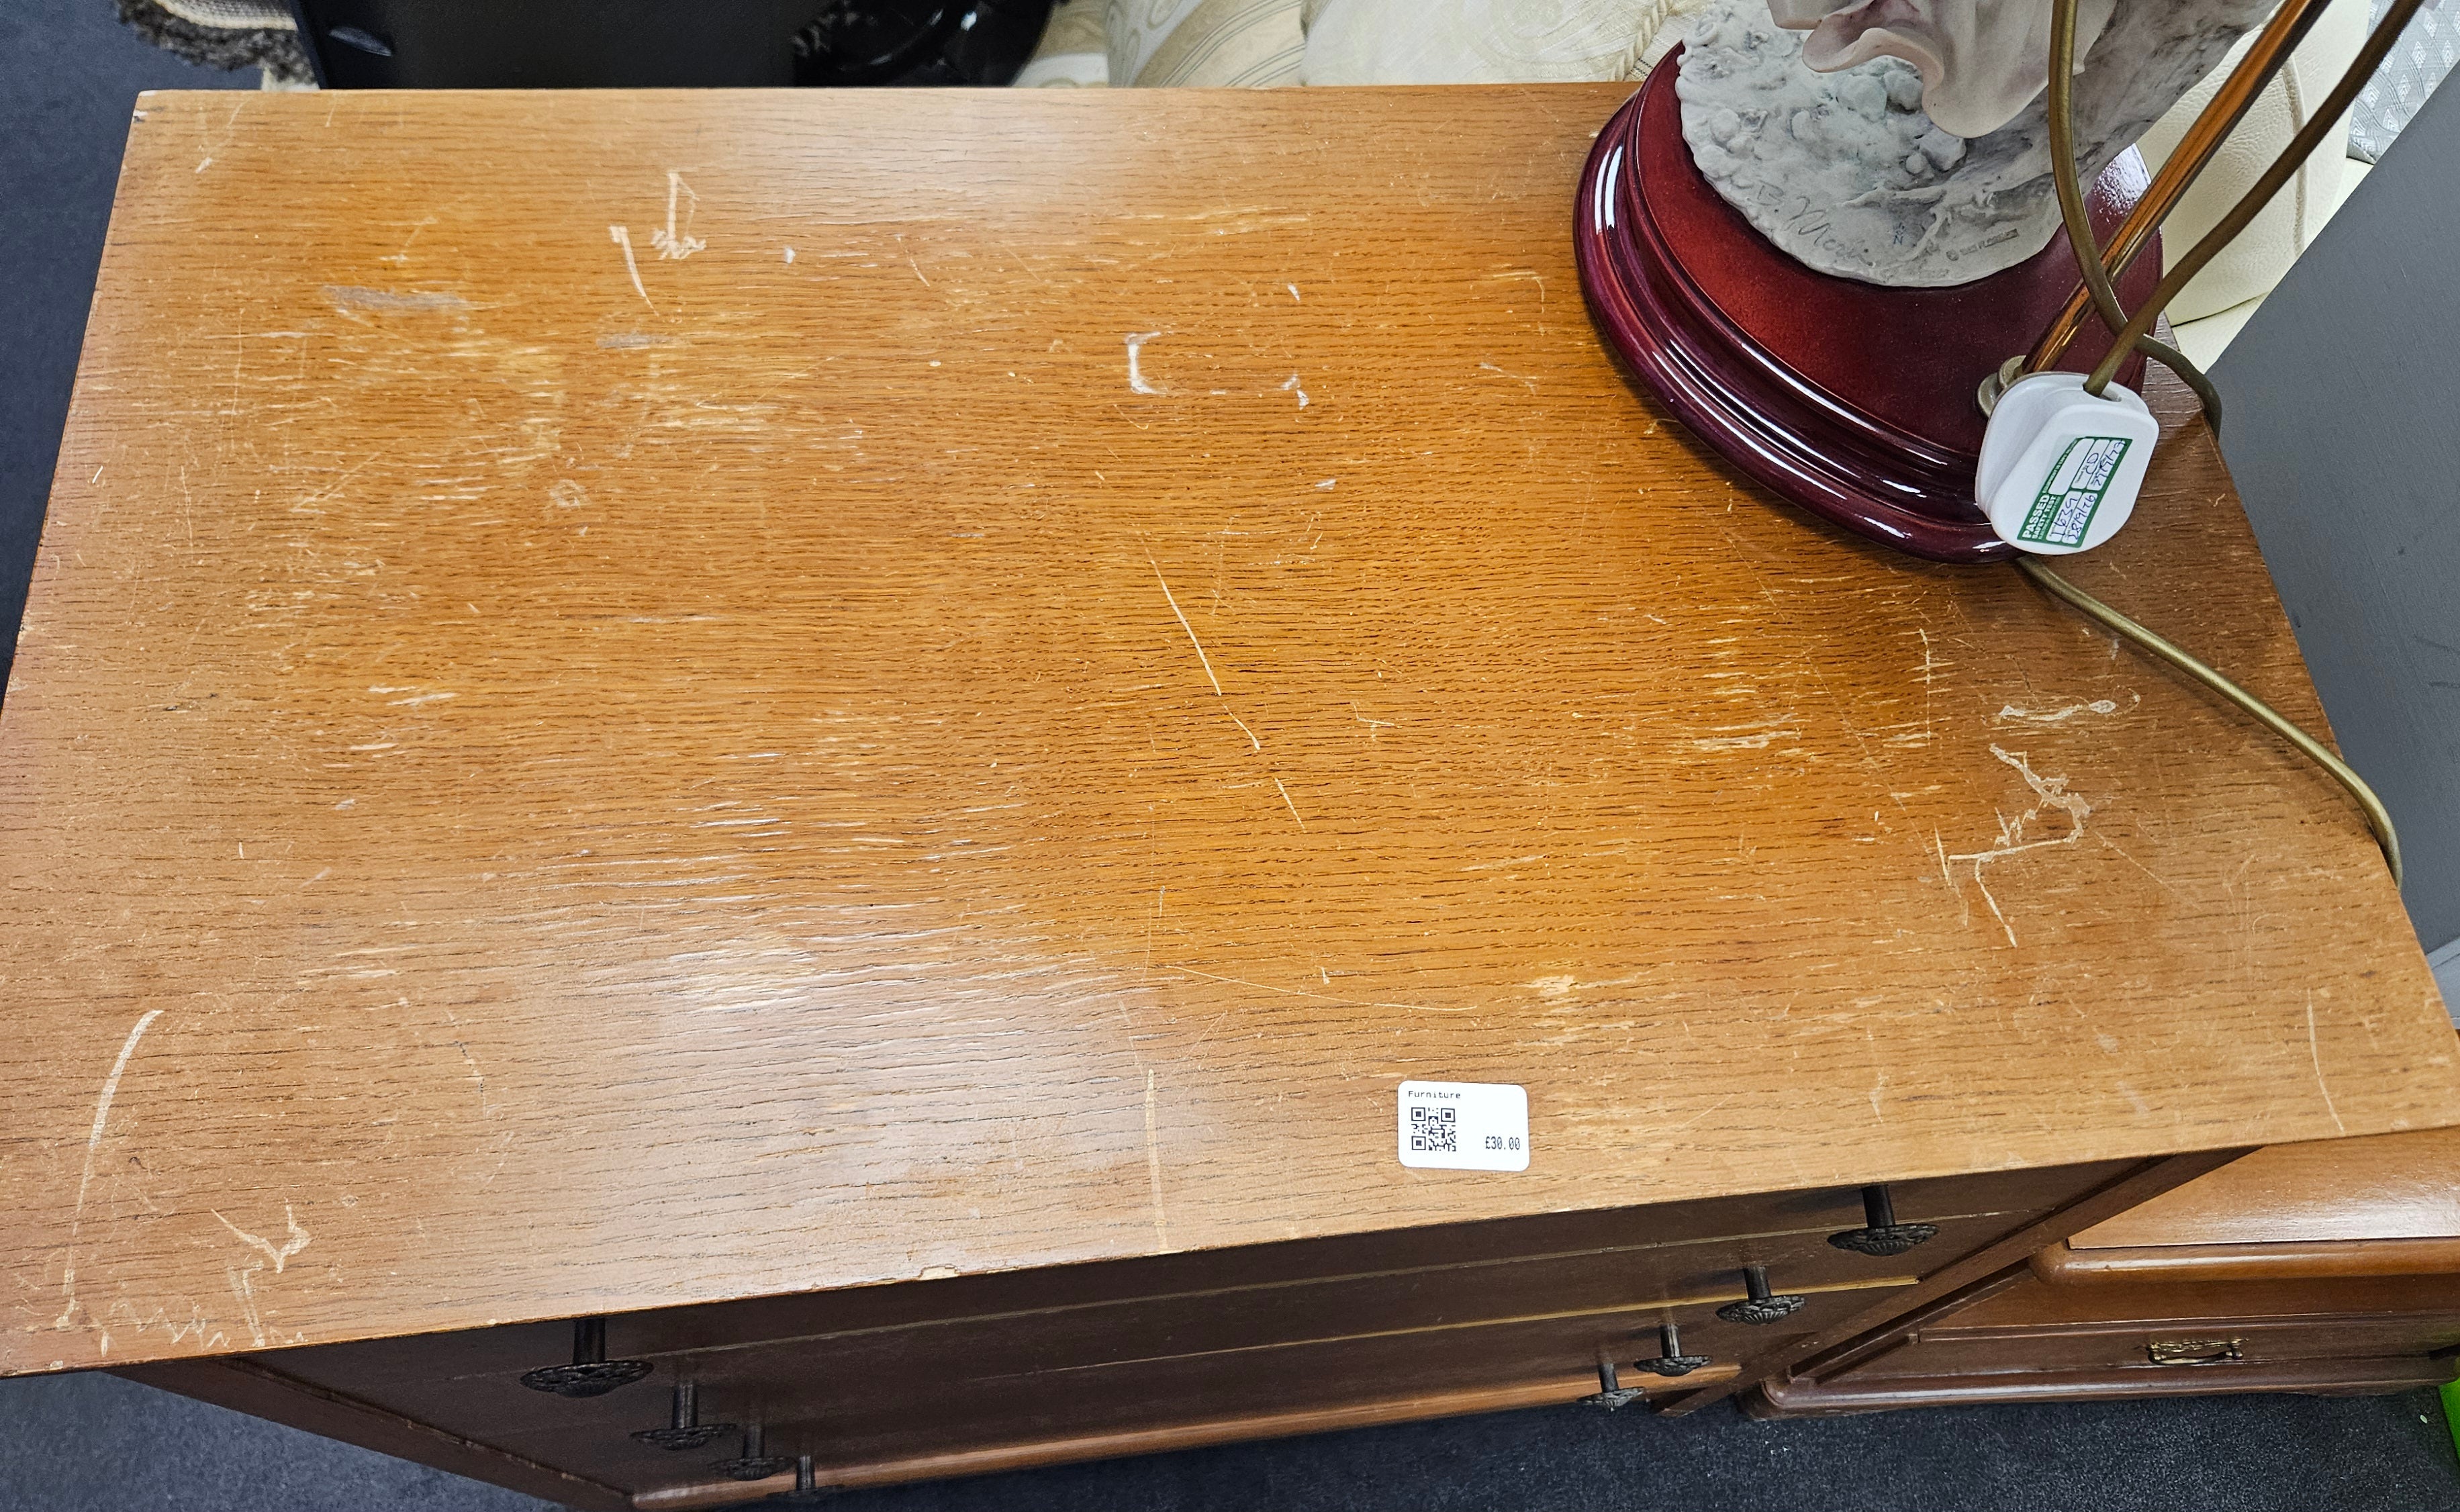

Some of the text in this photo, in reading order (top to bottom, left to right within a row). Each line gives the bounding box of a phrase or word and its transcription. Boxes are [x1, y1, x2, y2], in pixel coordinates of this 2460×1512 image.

[2046, 496, 2056, 514] TEST
[2022, 495, 2050, 538] PASSED
[1408, 1090, 1461, 1099] Furniture
[1485, 1136, 1521, 1151] £30.00
